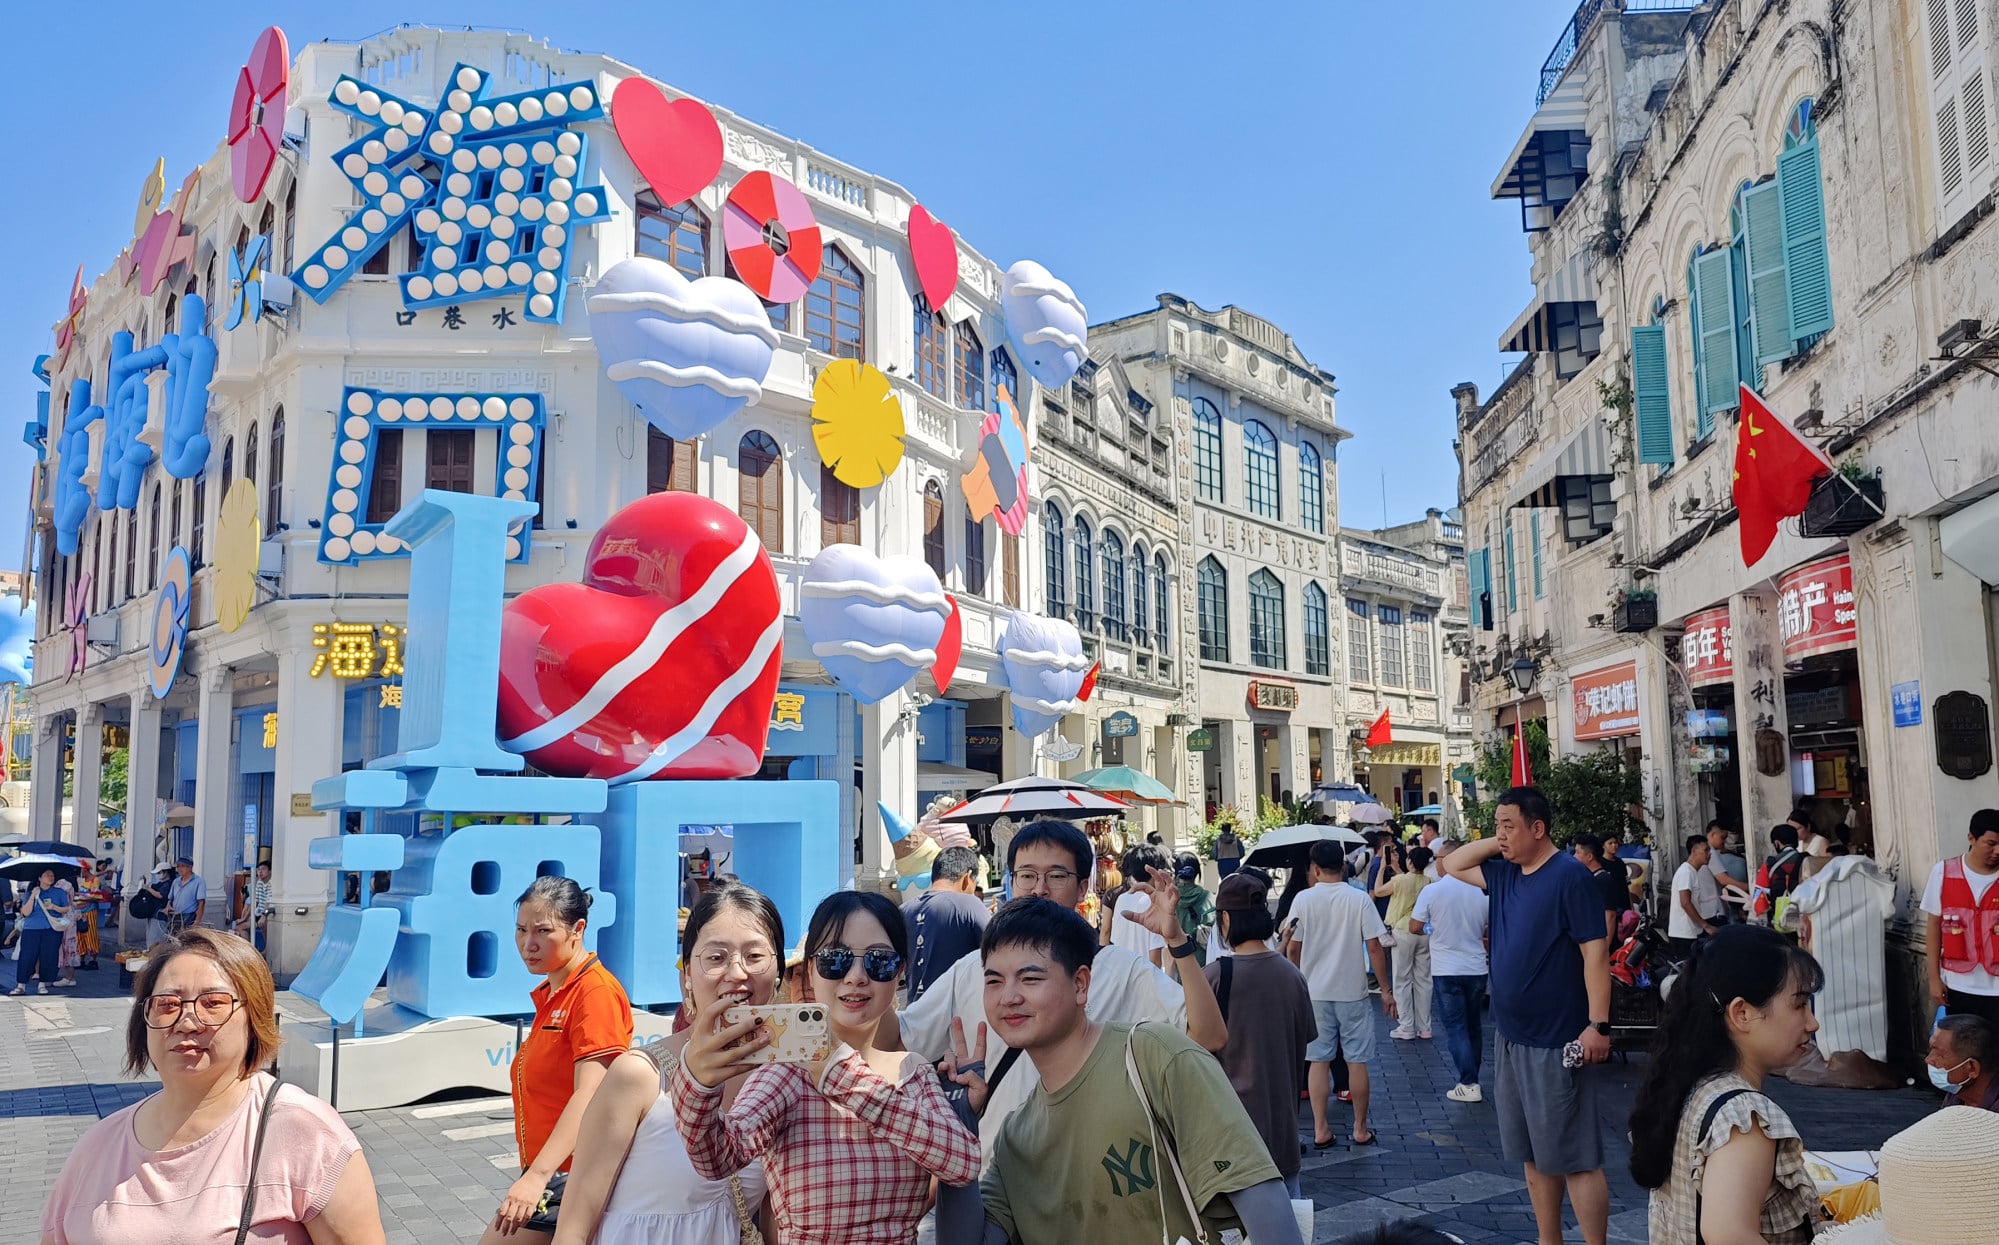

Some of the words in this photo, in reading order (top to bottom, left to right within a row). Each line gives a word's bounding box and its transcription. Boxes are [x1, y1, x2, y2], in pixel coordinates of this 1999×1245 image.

[1203, 509, 1320, 571] 中国共产党万岁
[1778, 581, 1827, 643] 特产
